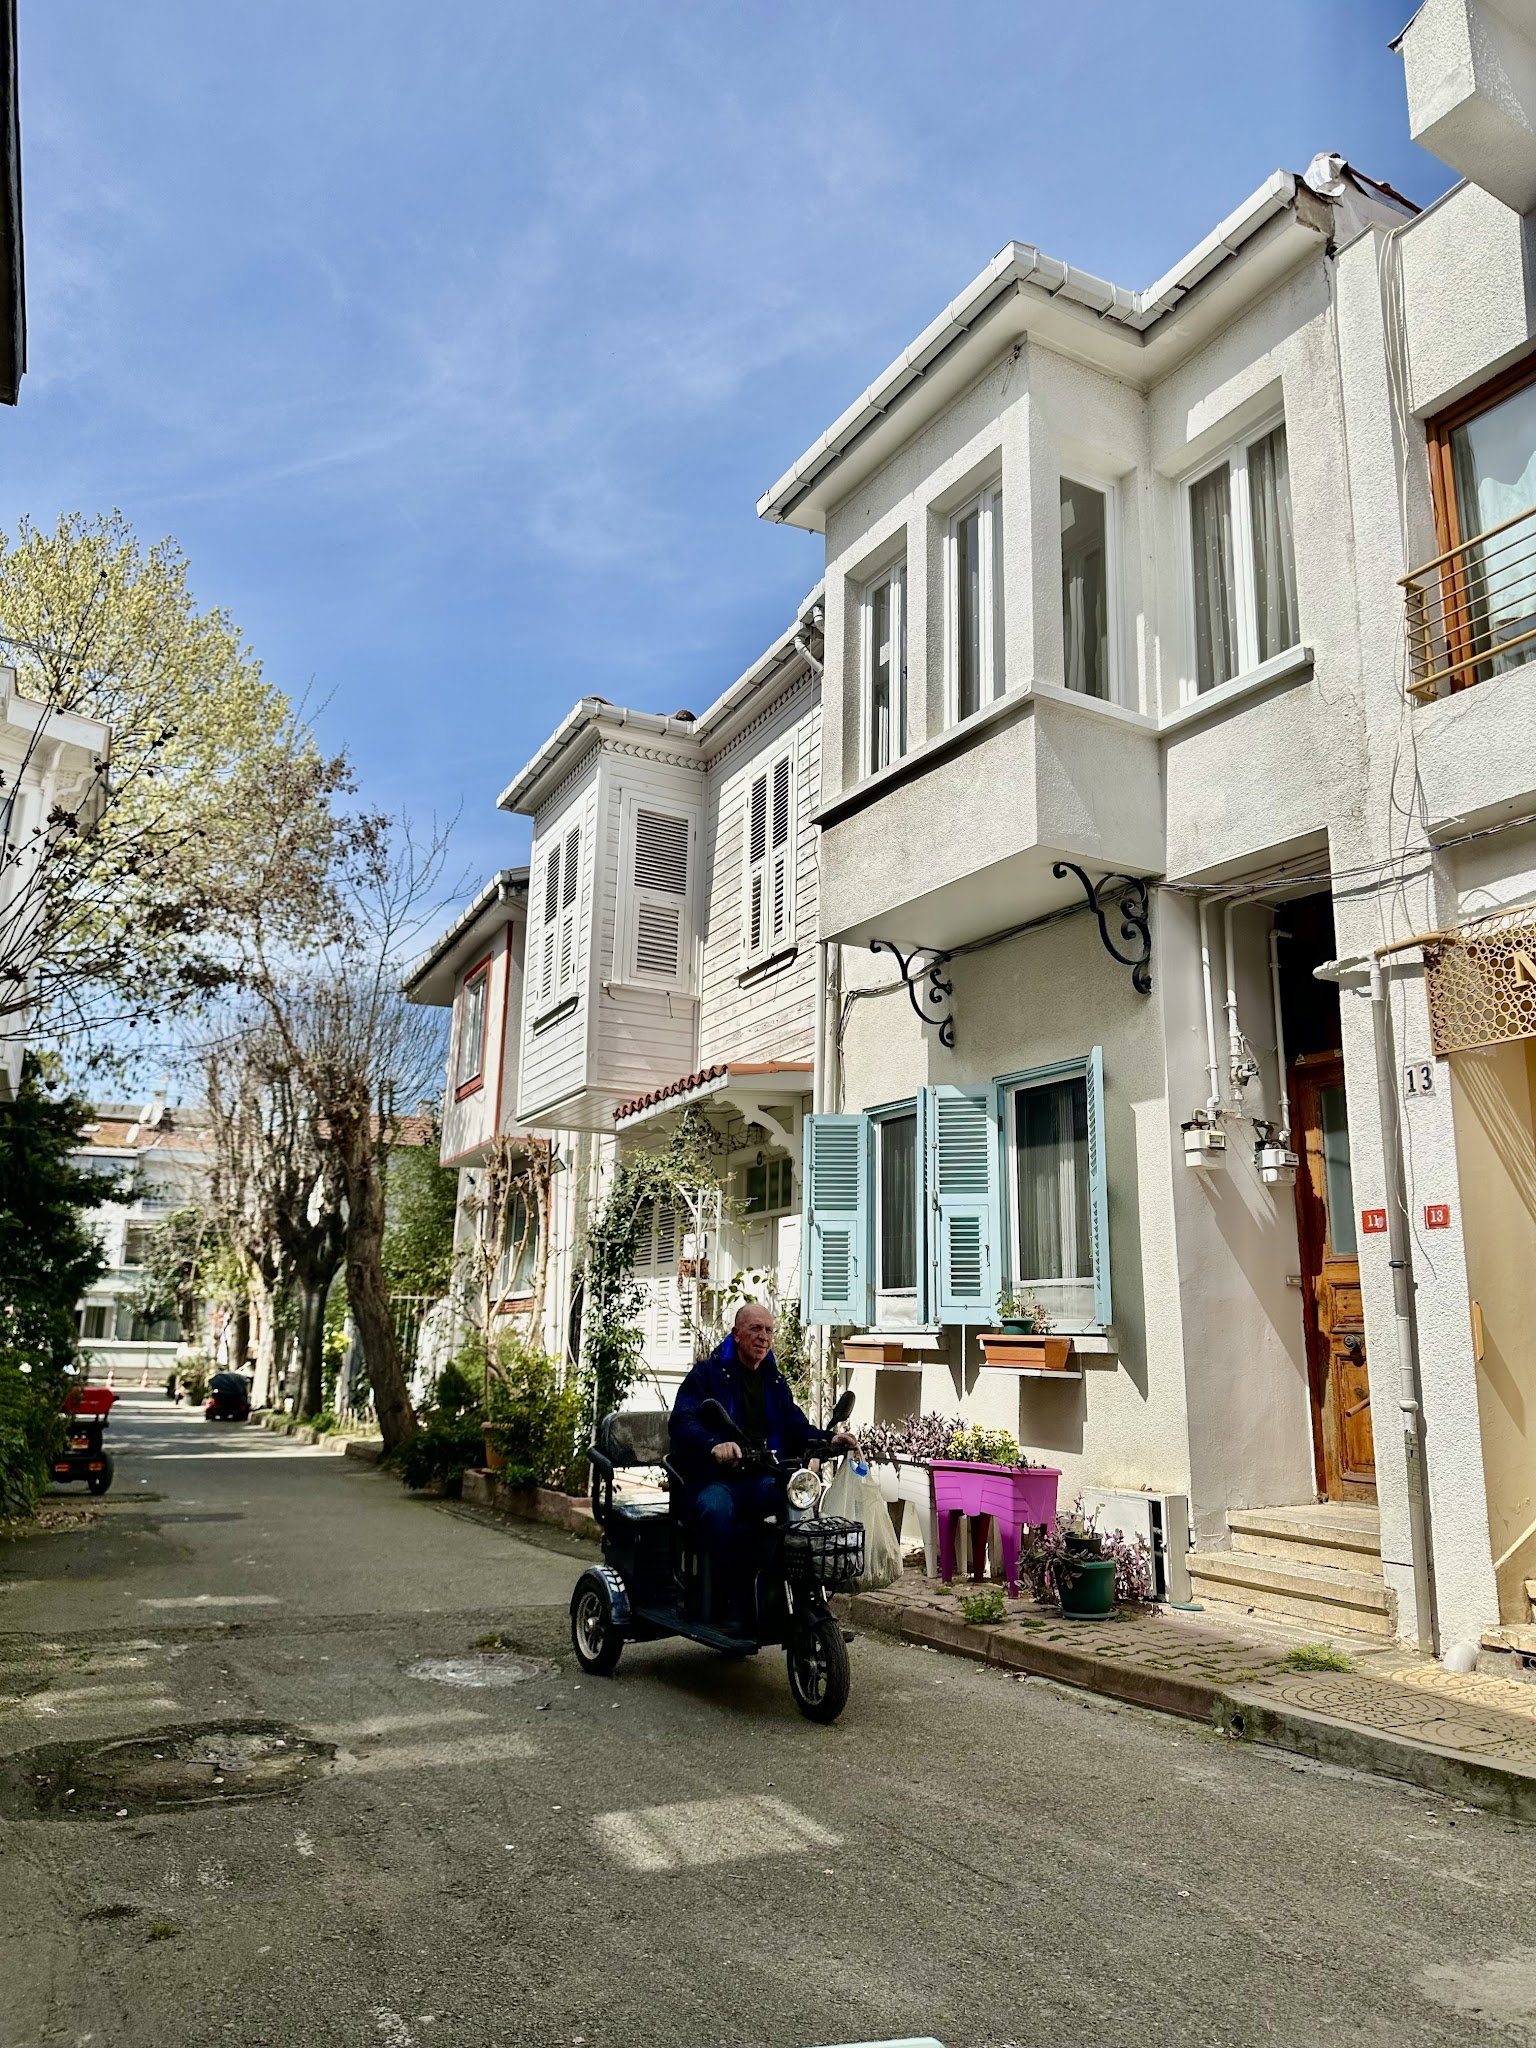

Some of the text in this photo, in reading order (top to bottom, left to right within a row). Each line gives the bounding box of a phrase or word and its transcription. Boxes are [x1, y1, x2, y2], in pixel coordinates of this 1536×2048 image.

[1406, 1066, 1433, 1093] 13
[1367, 1214, 1381, 1227] 11
[1430, 1210, 1444, 1223] 13
